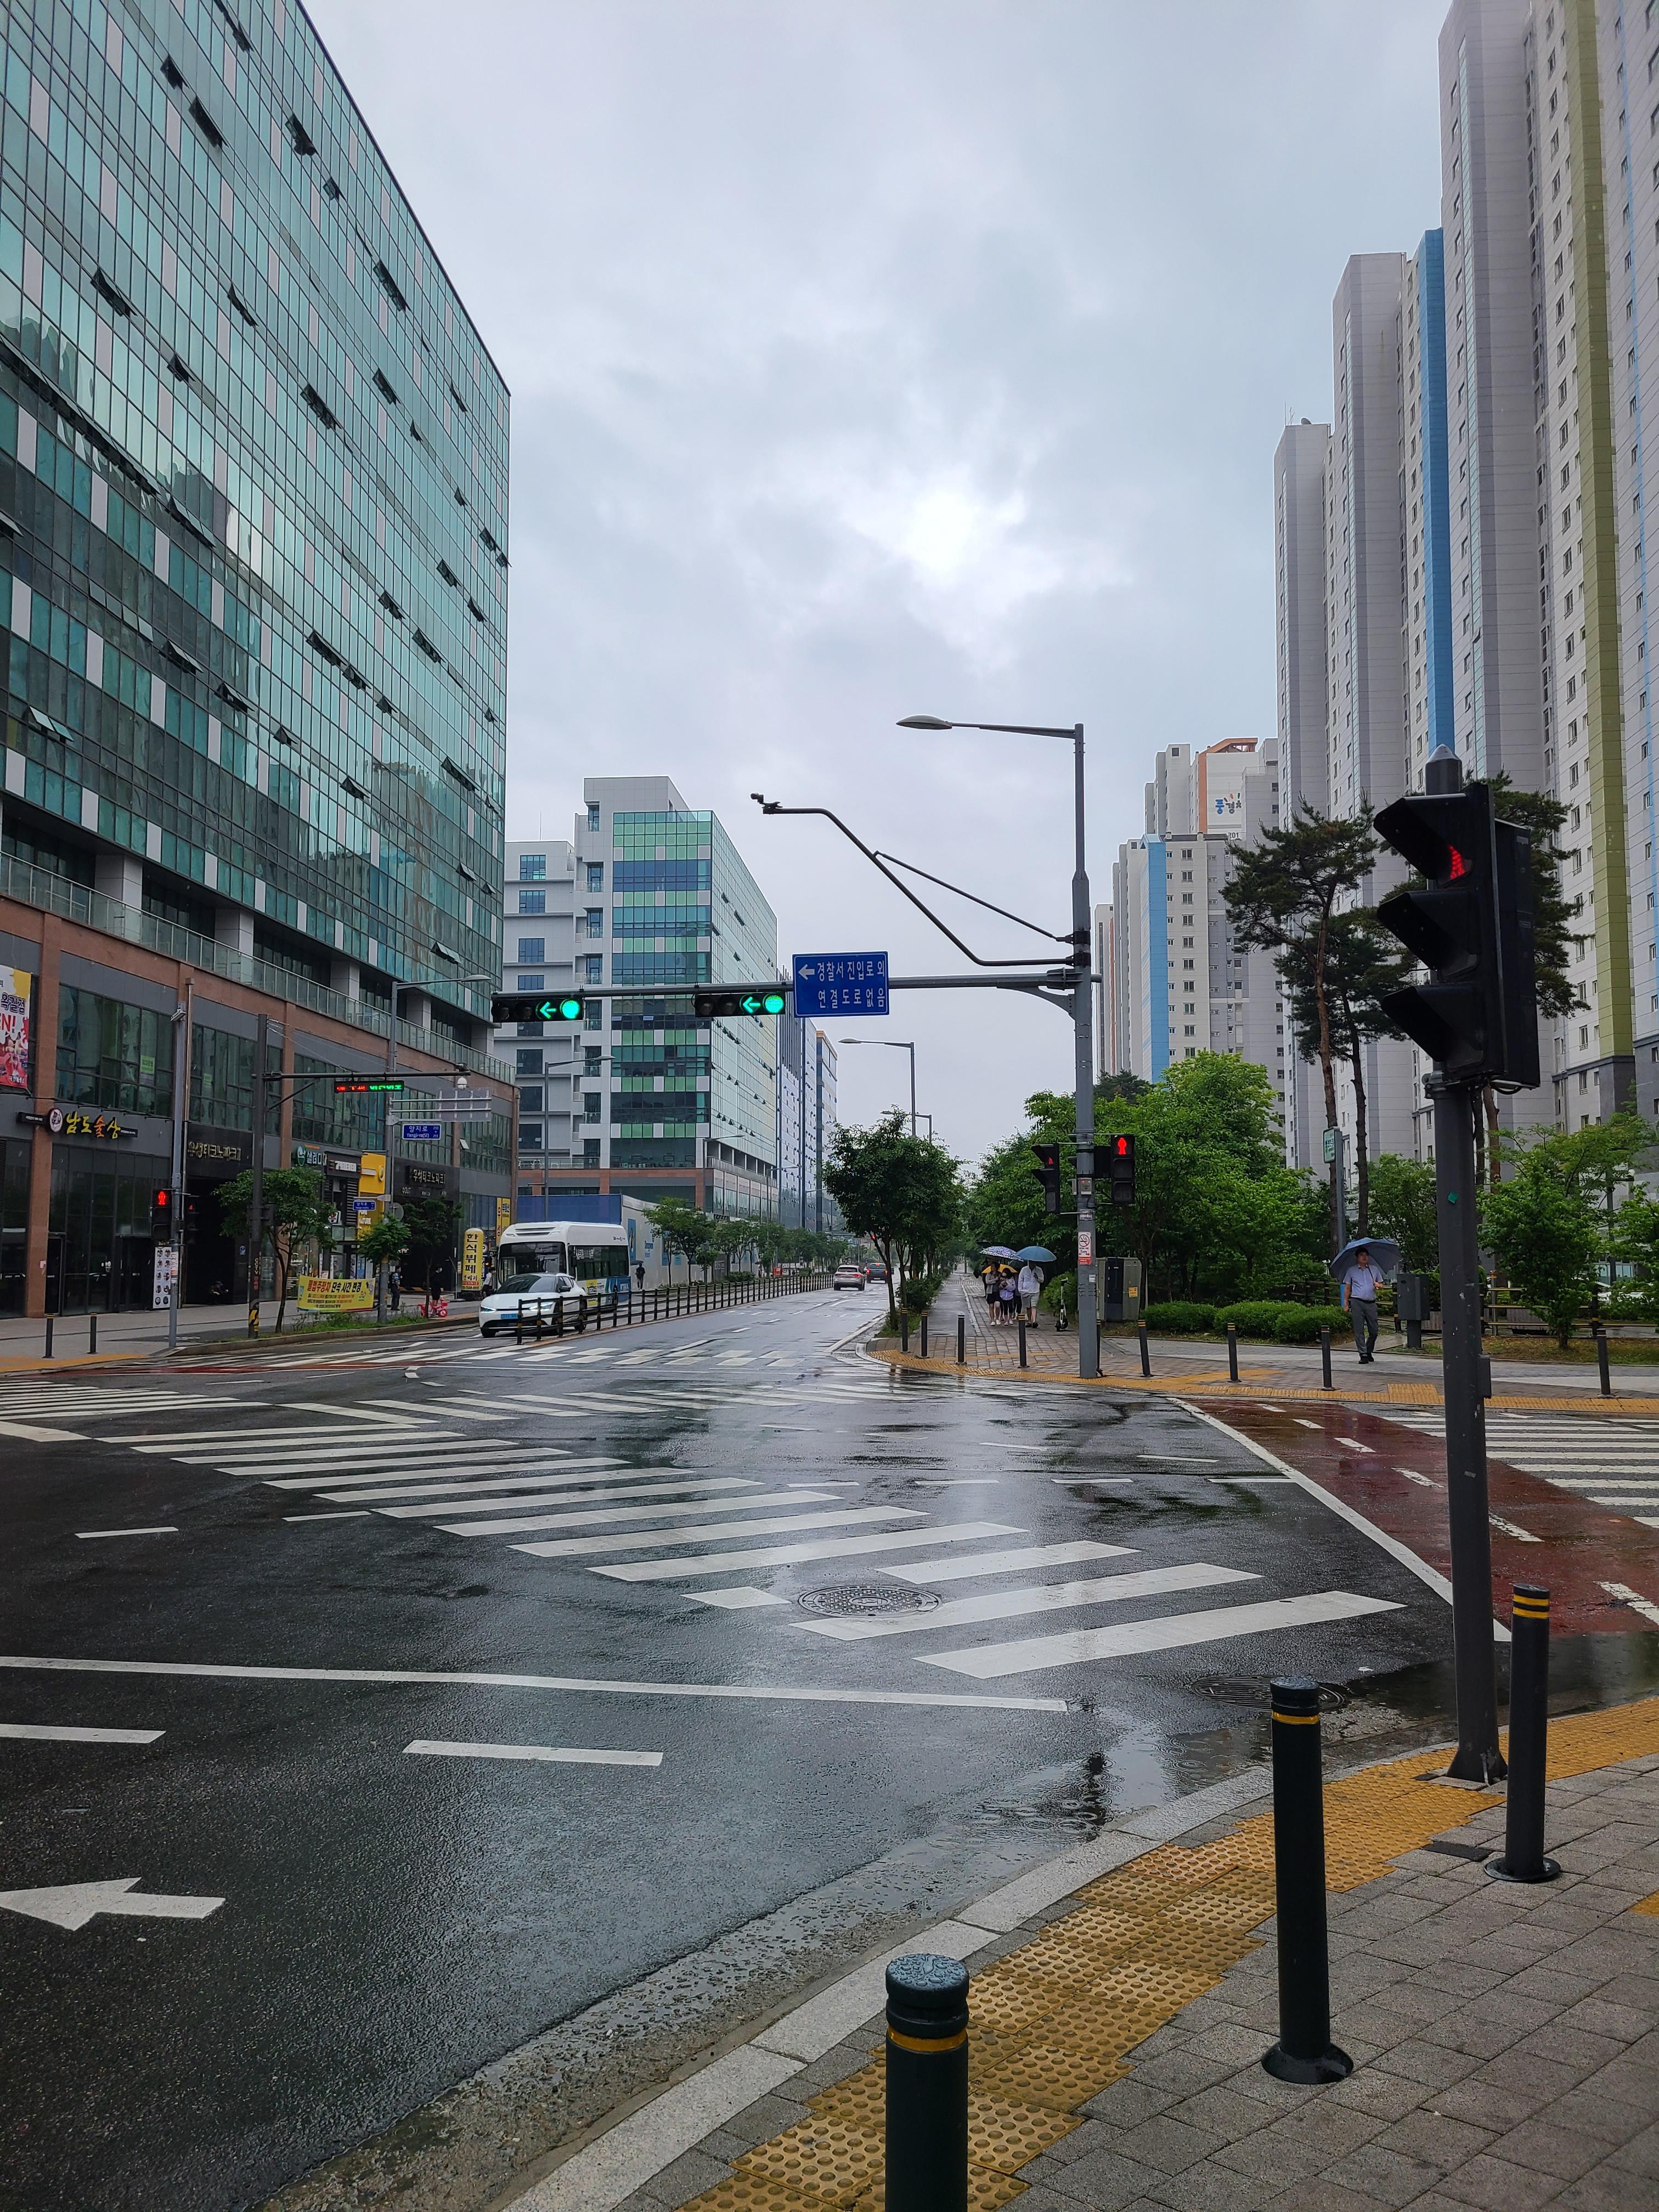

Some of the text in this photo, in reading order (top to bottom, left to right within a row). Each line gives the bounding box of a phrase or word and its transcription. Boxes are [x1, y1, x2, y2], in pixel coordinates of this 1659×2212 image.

[817, 960, 885, 982] 경찰서 진입로 외
[818, 988, 885, 1009] 연결도로 없음
[0, 1013, 16, 1034] N!
[66, 1111, 121, 1139] 남도술상
[465, 1233, 478, 1274] 한식뷔페
[341, 1281, 352, 1293] 시간
[352, 1281, 362, 1293] 변경
